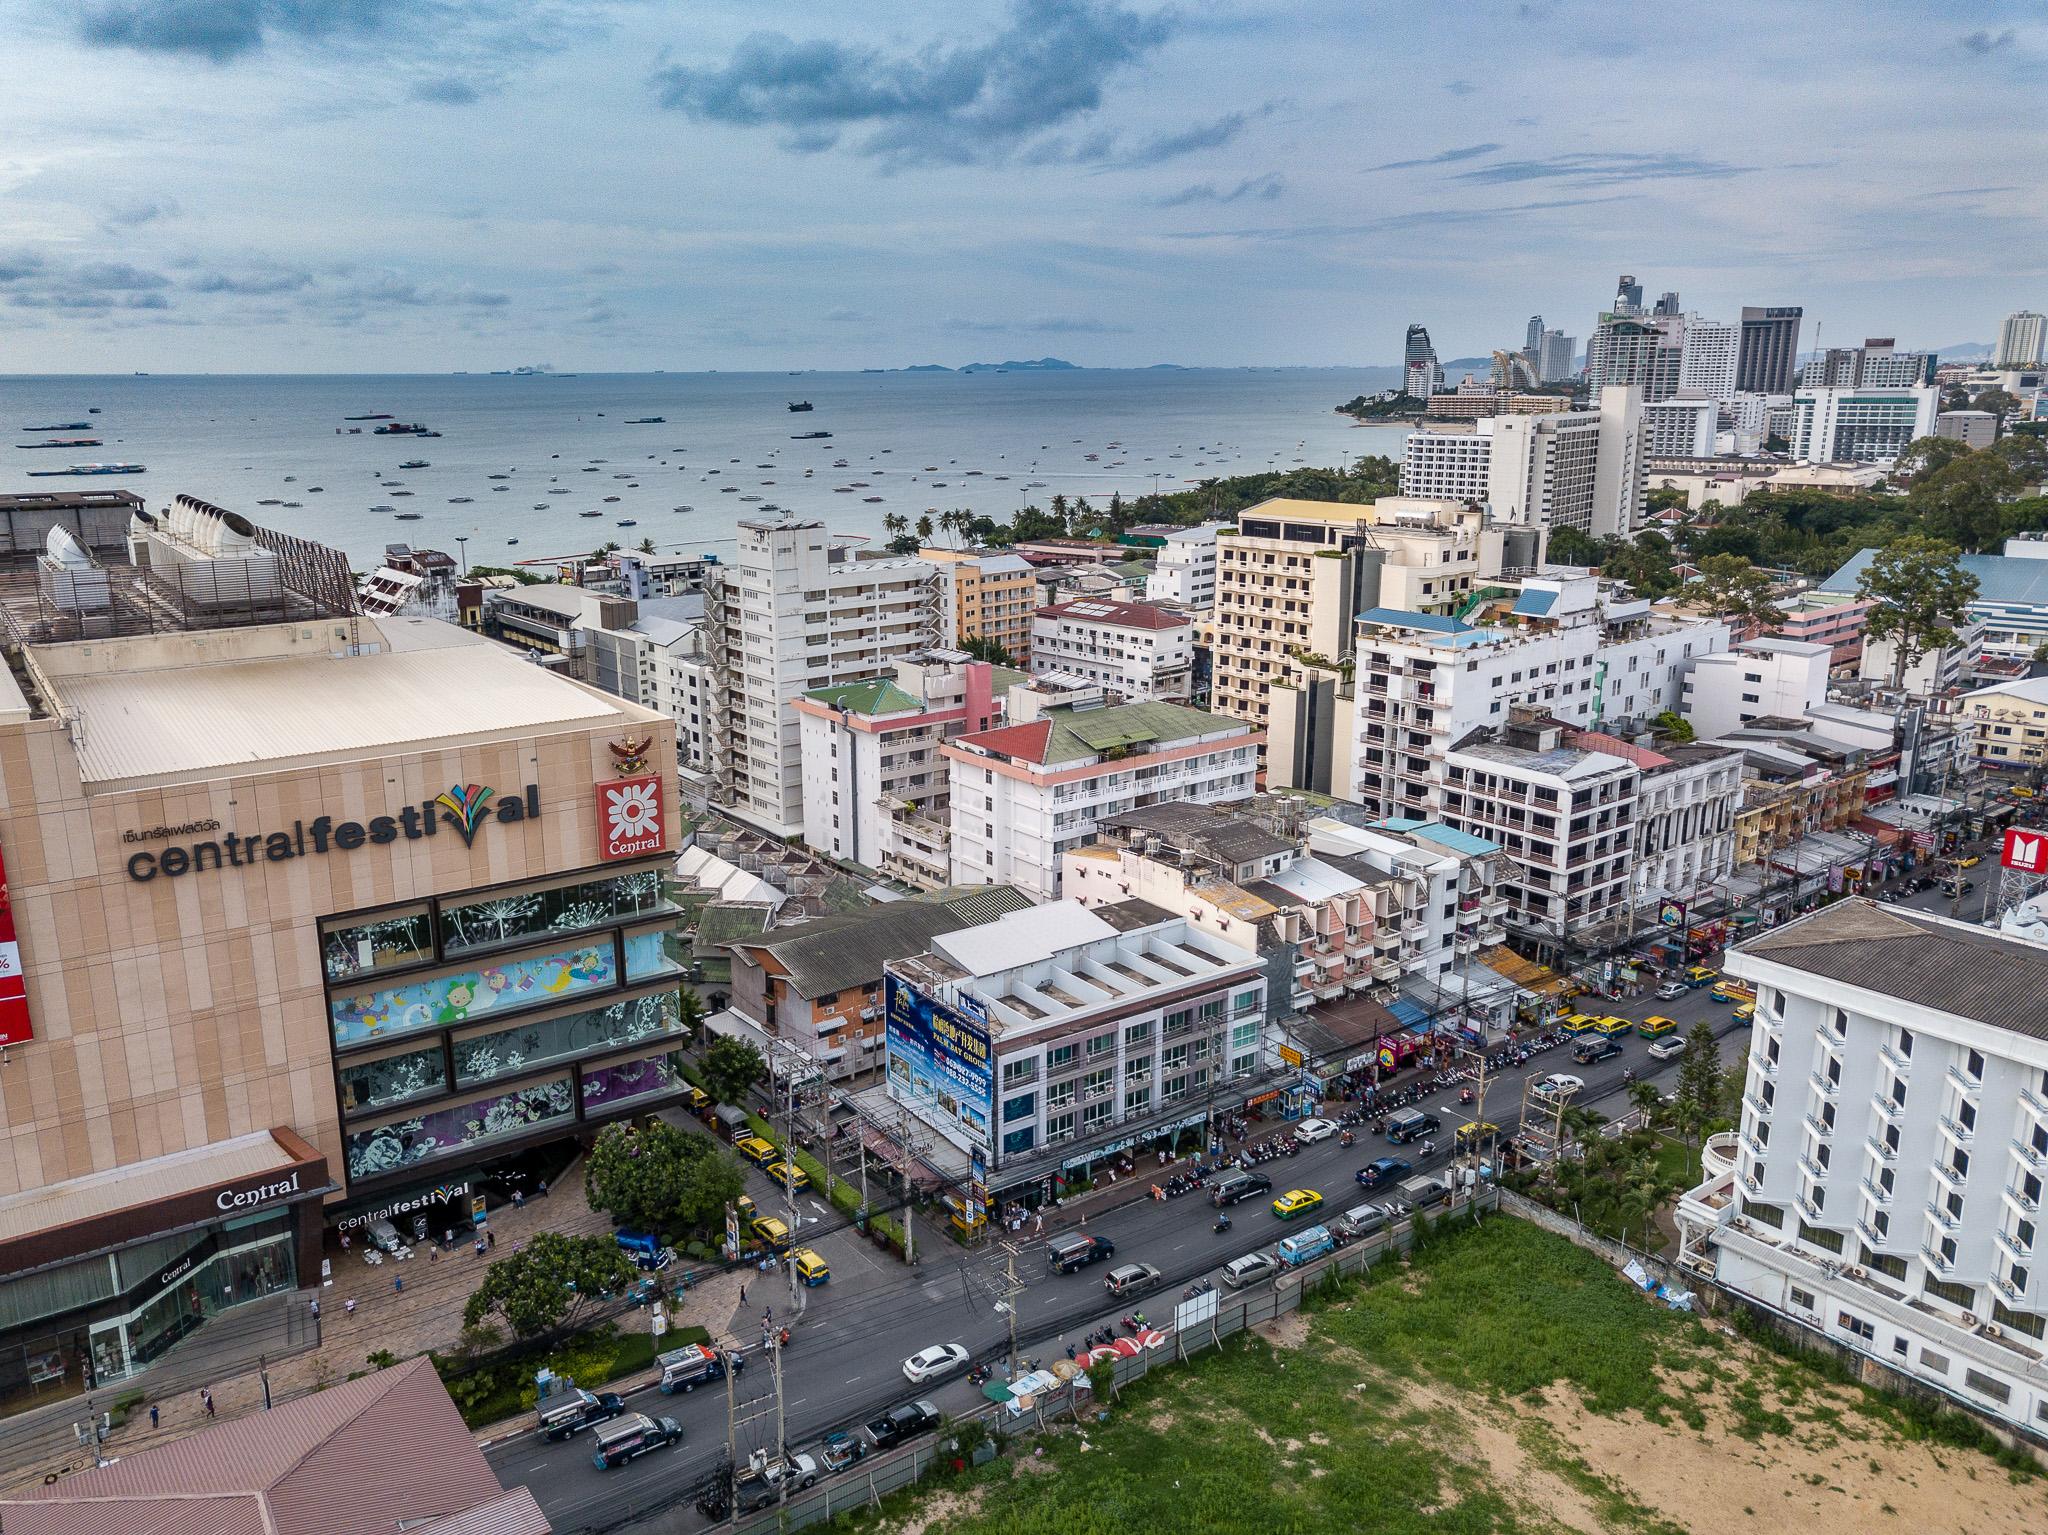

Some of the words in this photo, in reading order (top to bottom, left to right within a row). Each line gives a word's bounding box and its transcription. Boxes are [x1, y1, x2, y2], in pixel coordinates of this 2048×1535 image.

[123, 819, 220, 843] เซ็นทรัลเฟสติวัล
[128, 784, 540, 881] centralfestival
[609, 833, 661, 855] Central
[2011, 860, 2035, 869] ISUZU
[933, 1032, 949, 1048] PALM
[951, 1043, 963, 1056] BAY
[963, 1051, 988, 1069] GROUP
[216, 1172, 301, 1211] Central
[338, 1182, 469, 1231] centralfestival
[161, 1257, 191, 1284] Central
